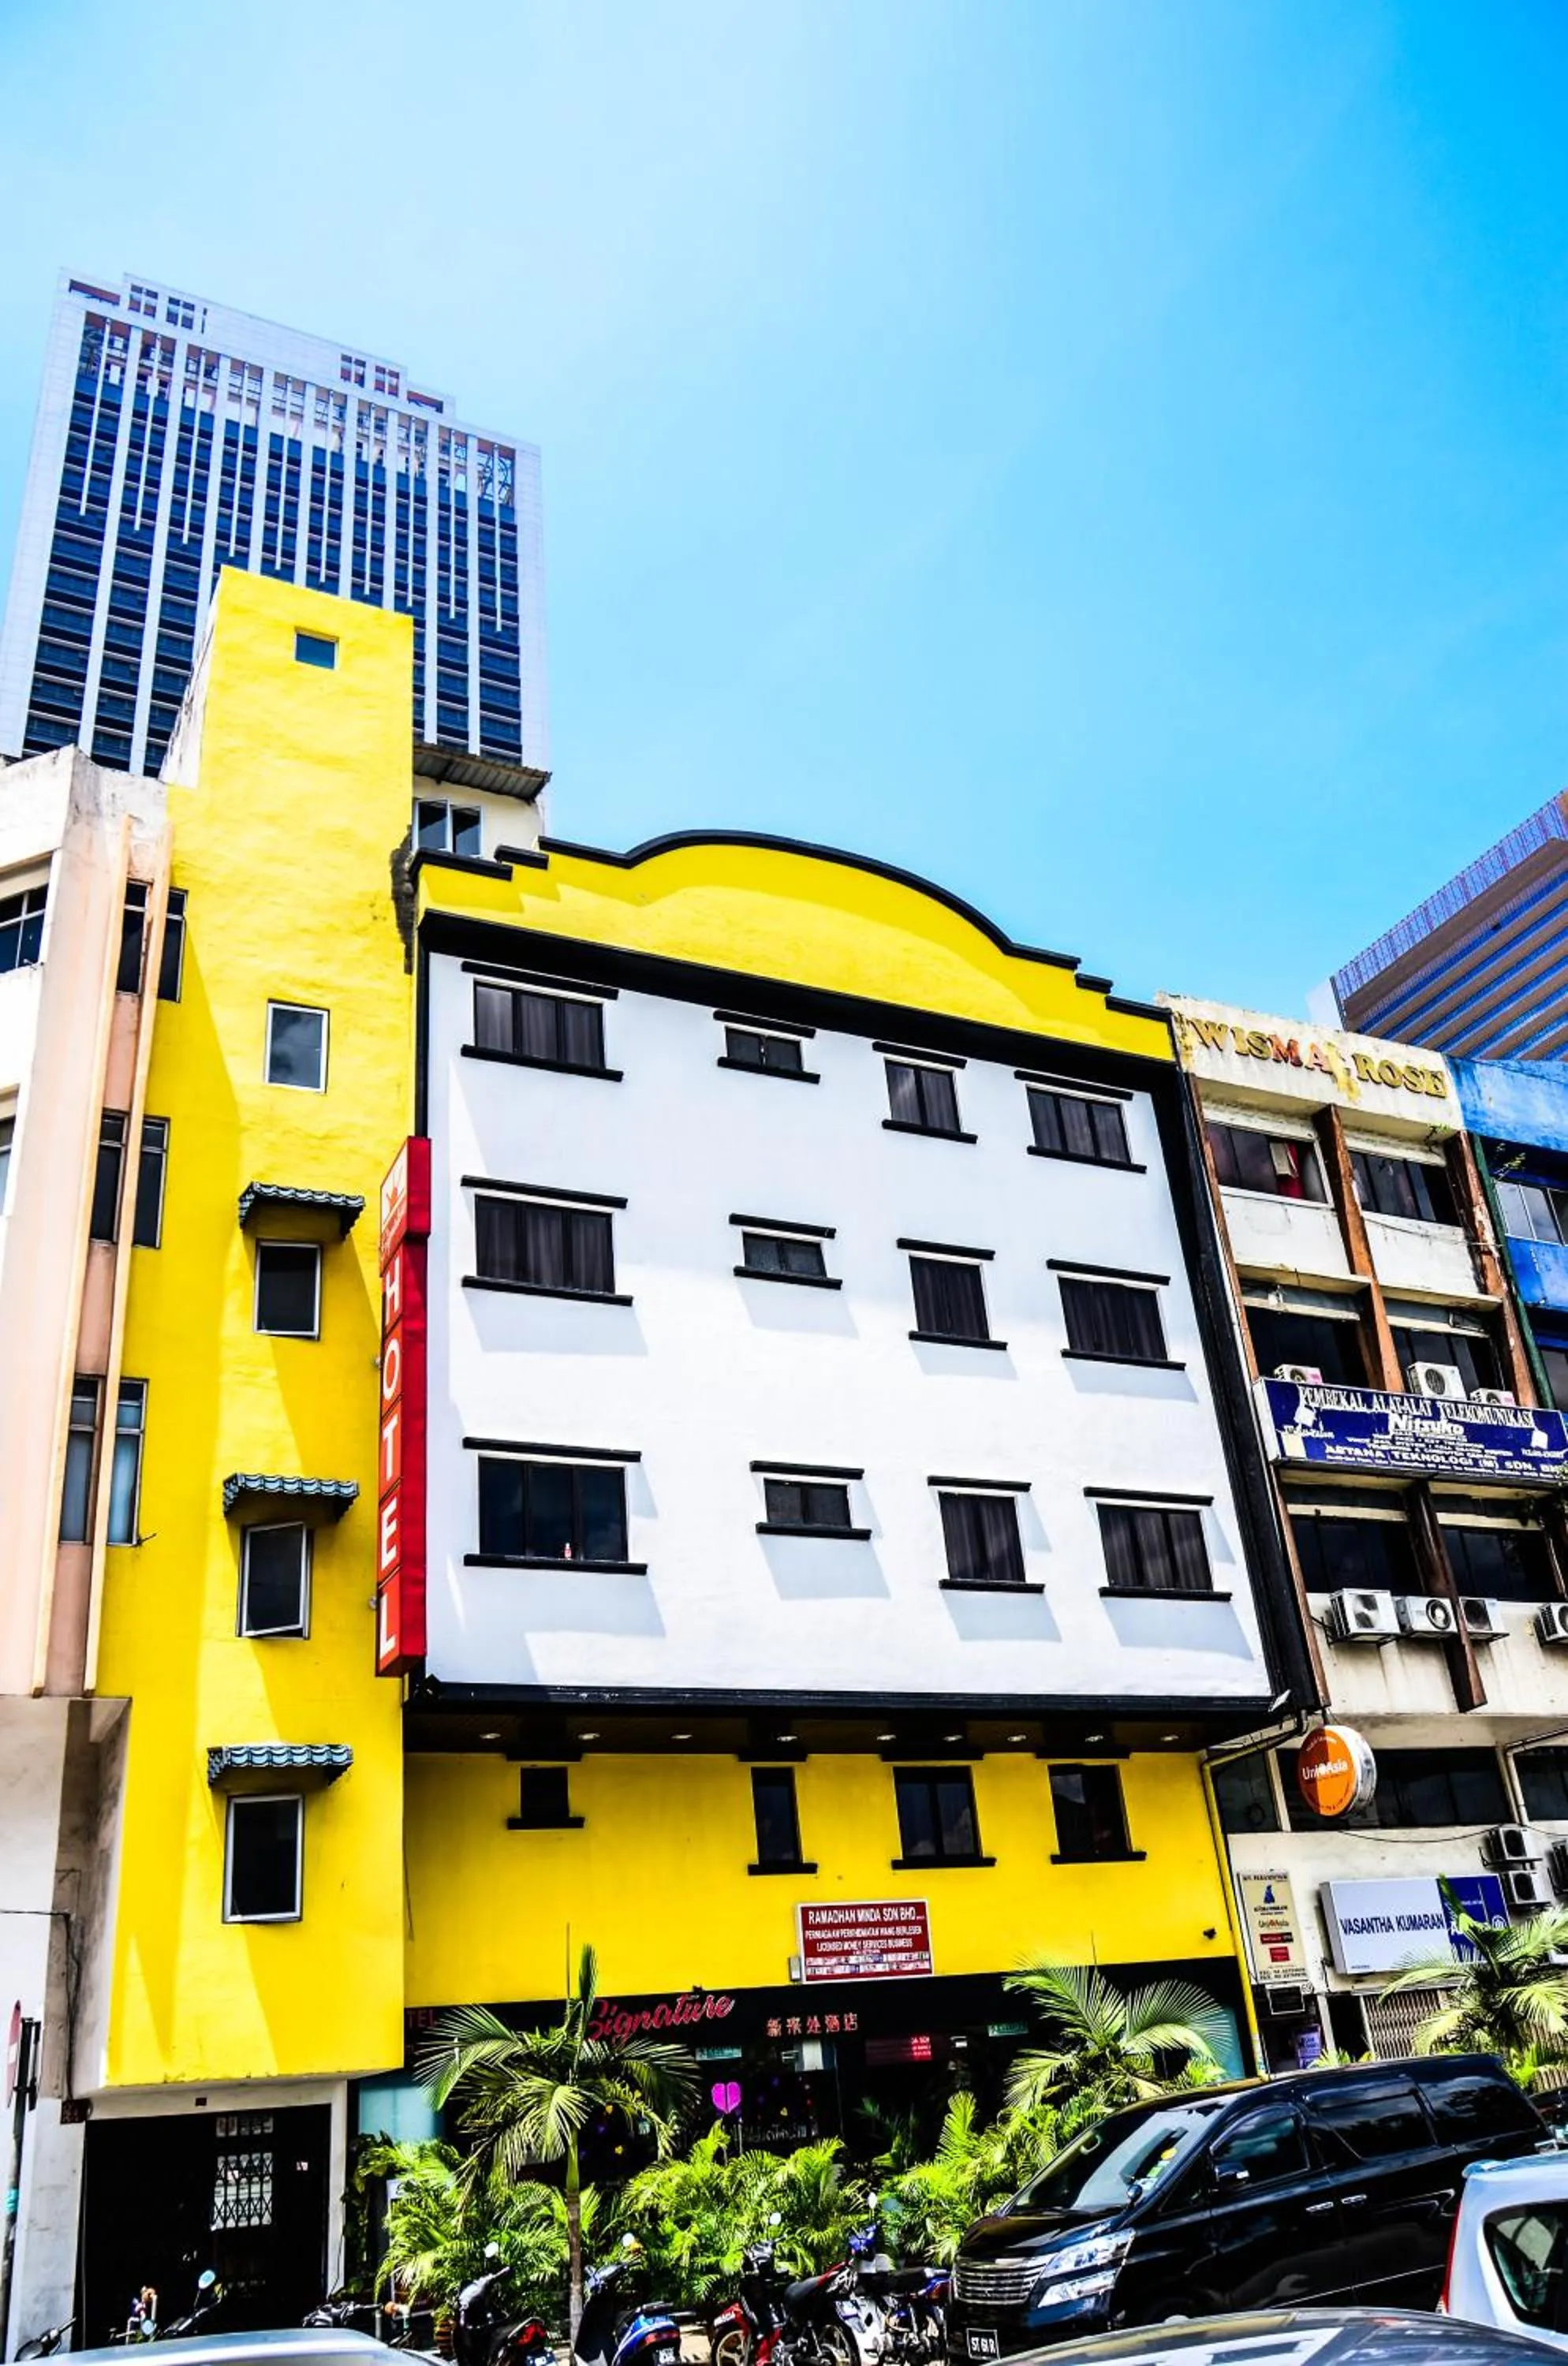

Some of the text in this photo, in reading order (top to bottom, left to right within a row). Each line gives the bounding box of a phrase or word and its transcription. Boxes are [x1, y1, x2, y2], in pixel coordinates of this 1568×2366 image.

[1185, 1018, 1448, 1099] WISMA ROSE
[1390, 1413, 1465, 1436] Nitsuko
[379, 1256, 400, 1659] HOTEL
[1391, 1450, 1474, 1466] TEKNOLOGI
[808, 1908, 856, 1925] RAMADHAN
[857, 1907, 882, 1922] MINDA
[1340, 1916, 1394, 1935] VASANTHA
[1396, 1913, 1445, 1931] KUMARAN
[588, 1994, 736, 2045] Signature
